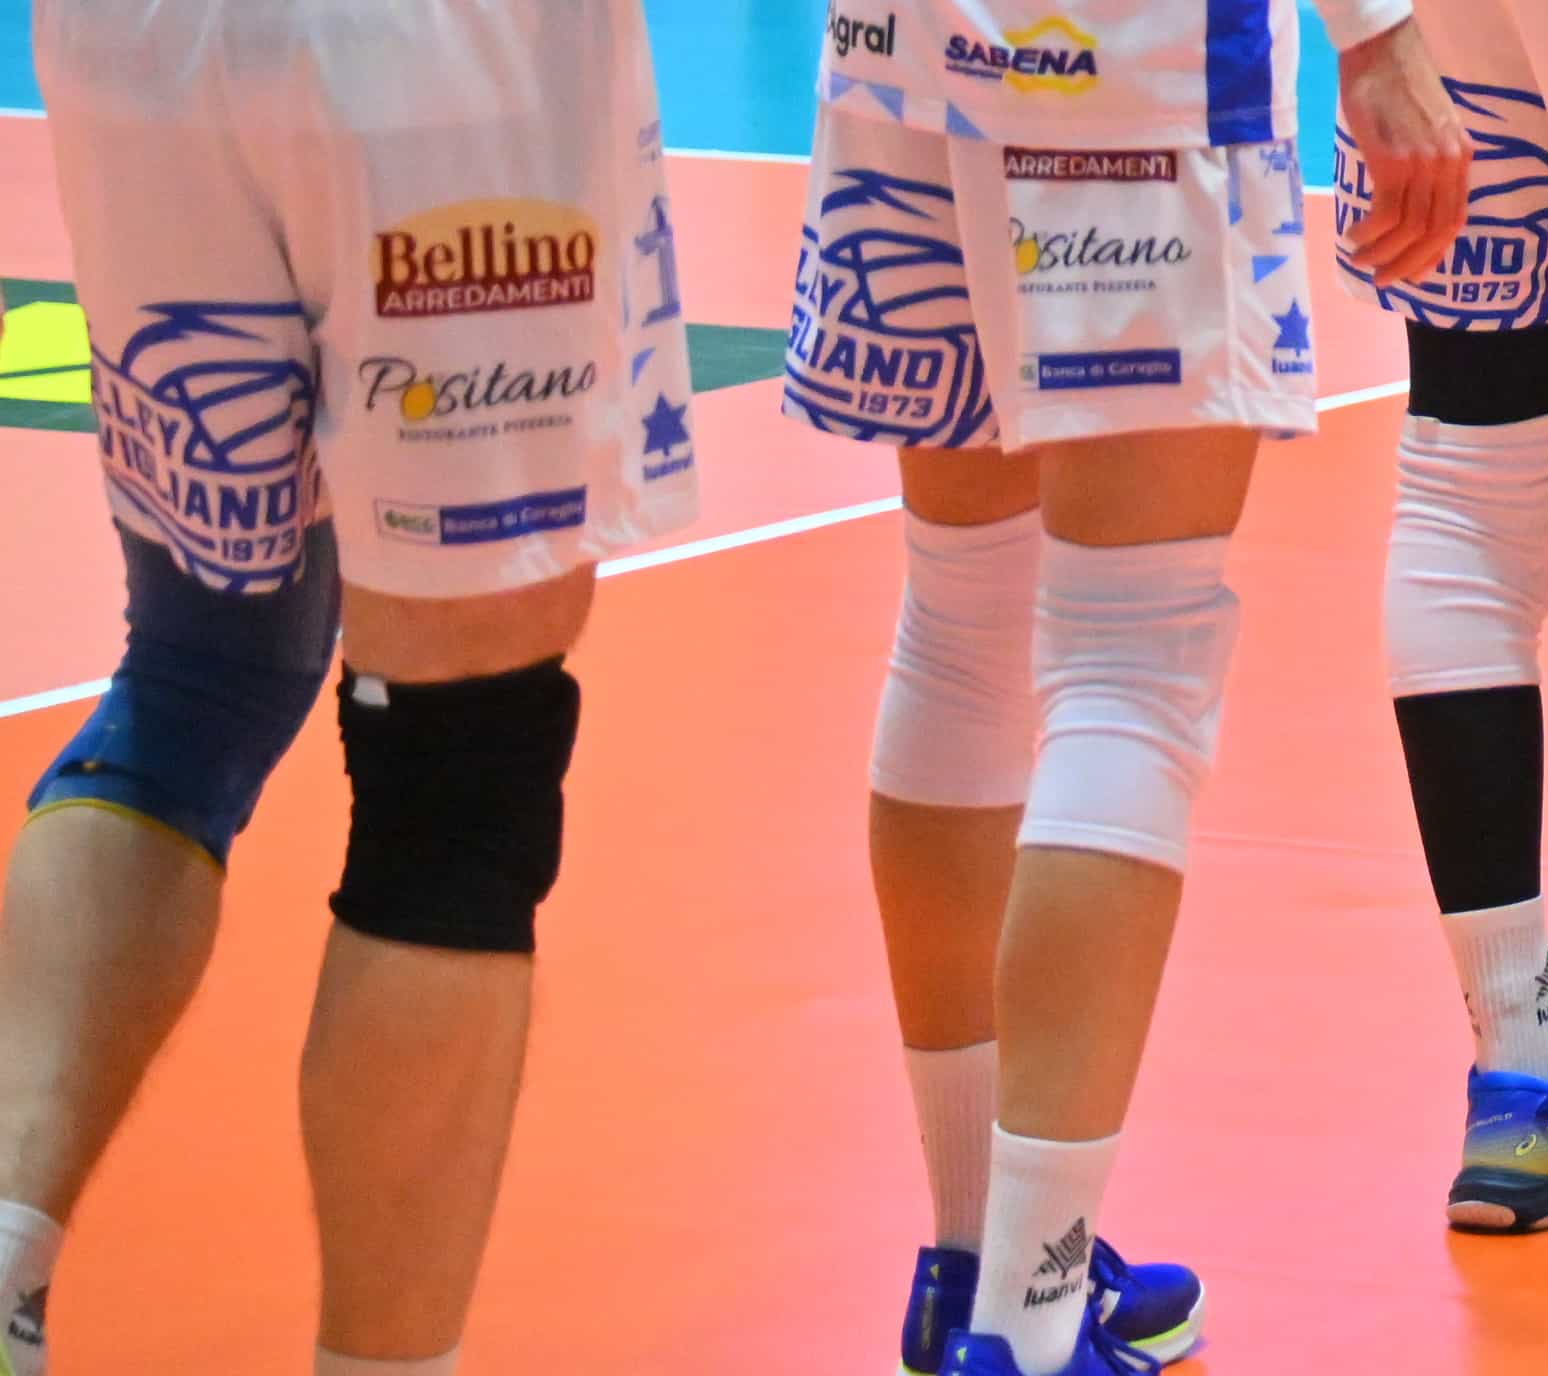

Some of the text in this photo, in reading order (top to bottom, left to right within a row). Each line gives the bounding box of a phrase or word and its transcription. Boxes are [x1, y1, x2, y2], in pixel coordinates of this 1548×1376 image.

[944, 35, 1099, 76] SABENA
[375, 222, 595, 285] Bellino
[382, 276, 590, 313] ARREDAMENTI
[1450, 280, 1520, 303] 1973
[858, 390, 934, 419] 1973
[221, 528, 298, 561] 1973
[1022, 1272, 1083, 1311] luanvi
